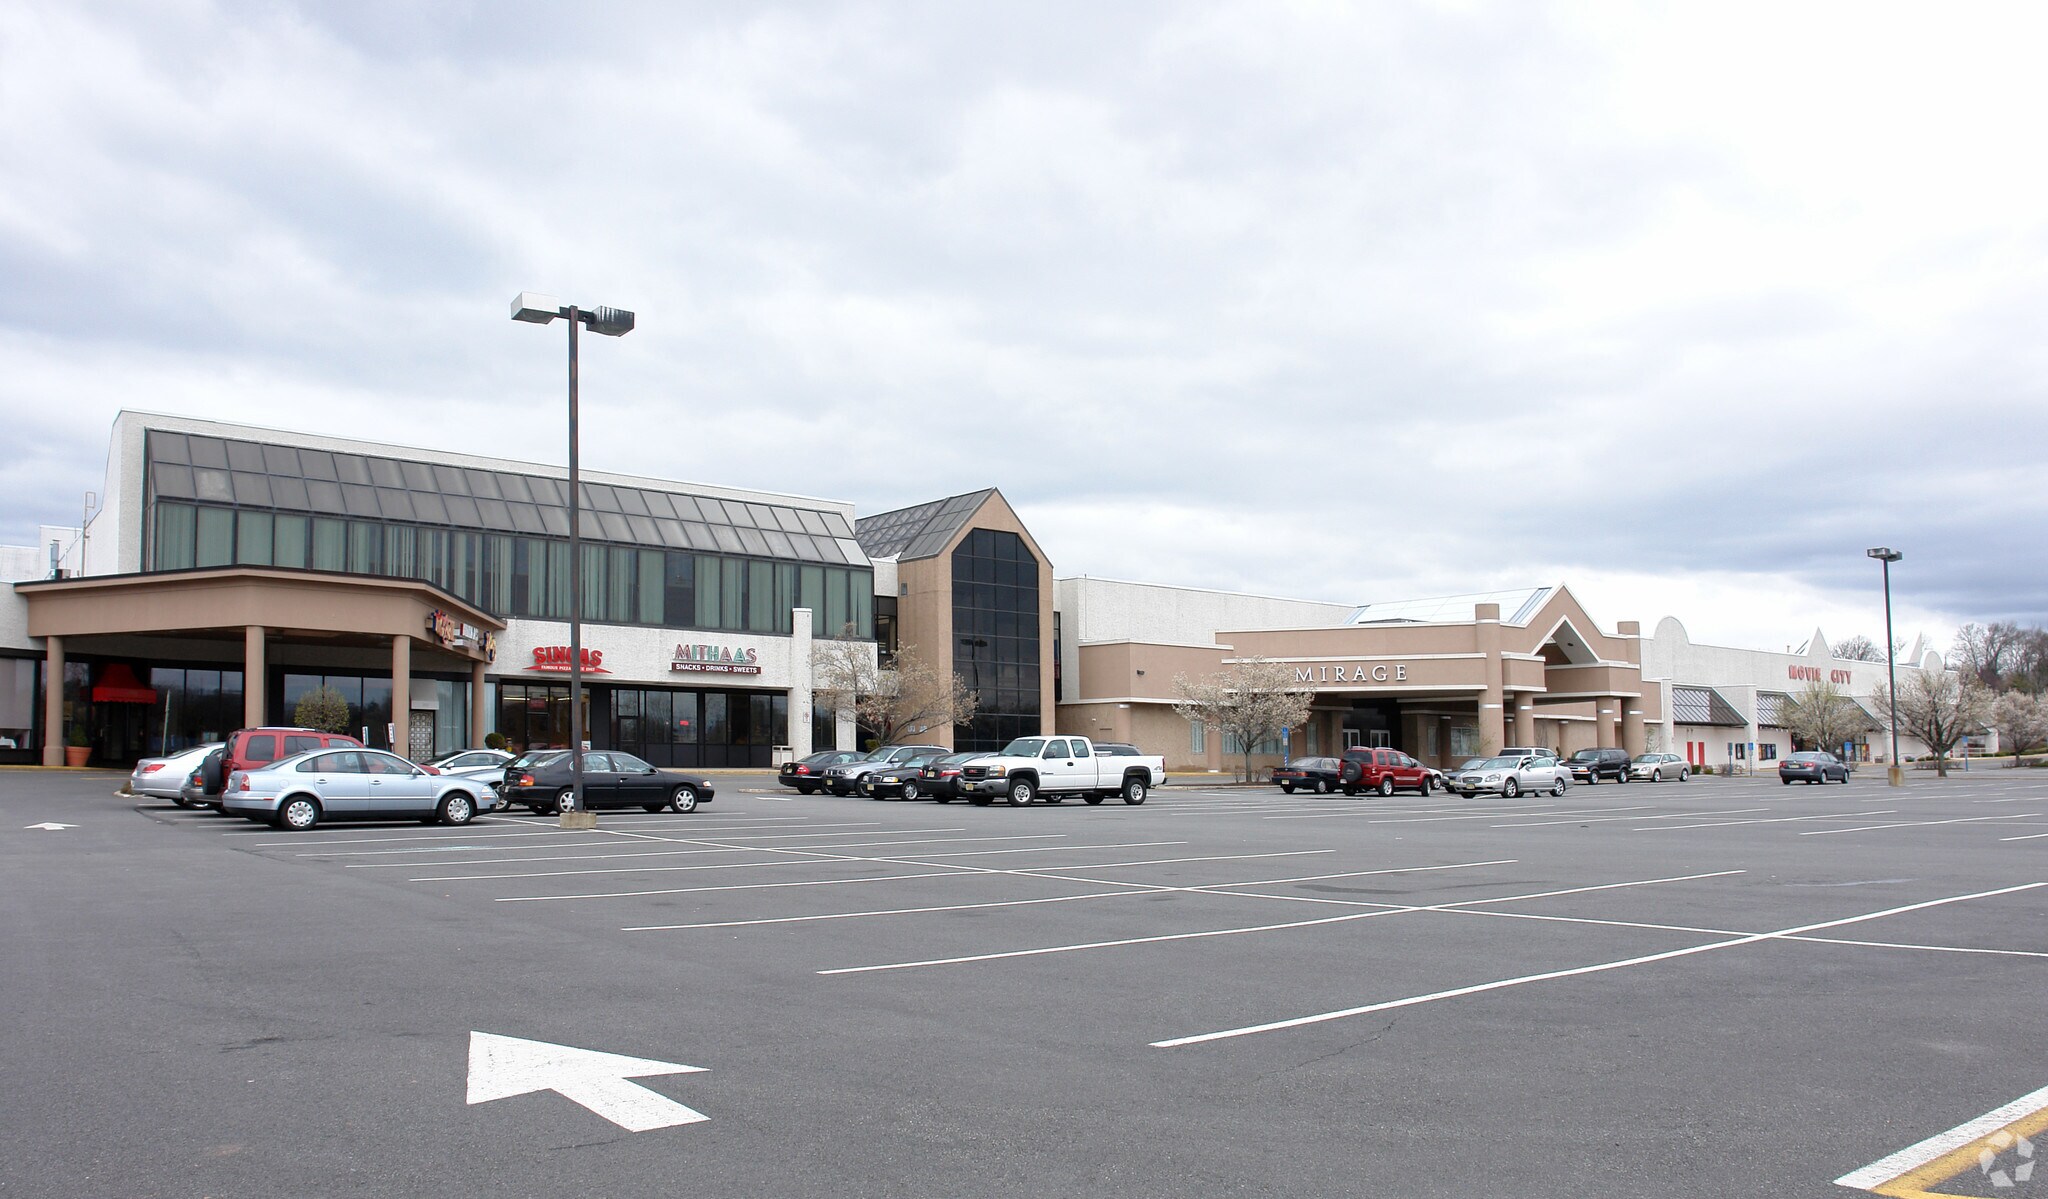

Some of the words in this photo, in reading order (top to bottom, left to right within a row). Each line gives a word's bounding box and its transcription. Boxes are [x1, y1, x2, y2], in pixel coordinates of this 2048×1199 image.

[675, 643, 758, 664] MITHAAS
[676, 663, 701, 671] SNACKS
[733, 666, 758, 674] SWEETS
[1295, 664, 1407, 682] MIRAGE
[1788, 664, 1821, 683] MOVIE
[1831, 669, 1852, 685] CITY
